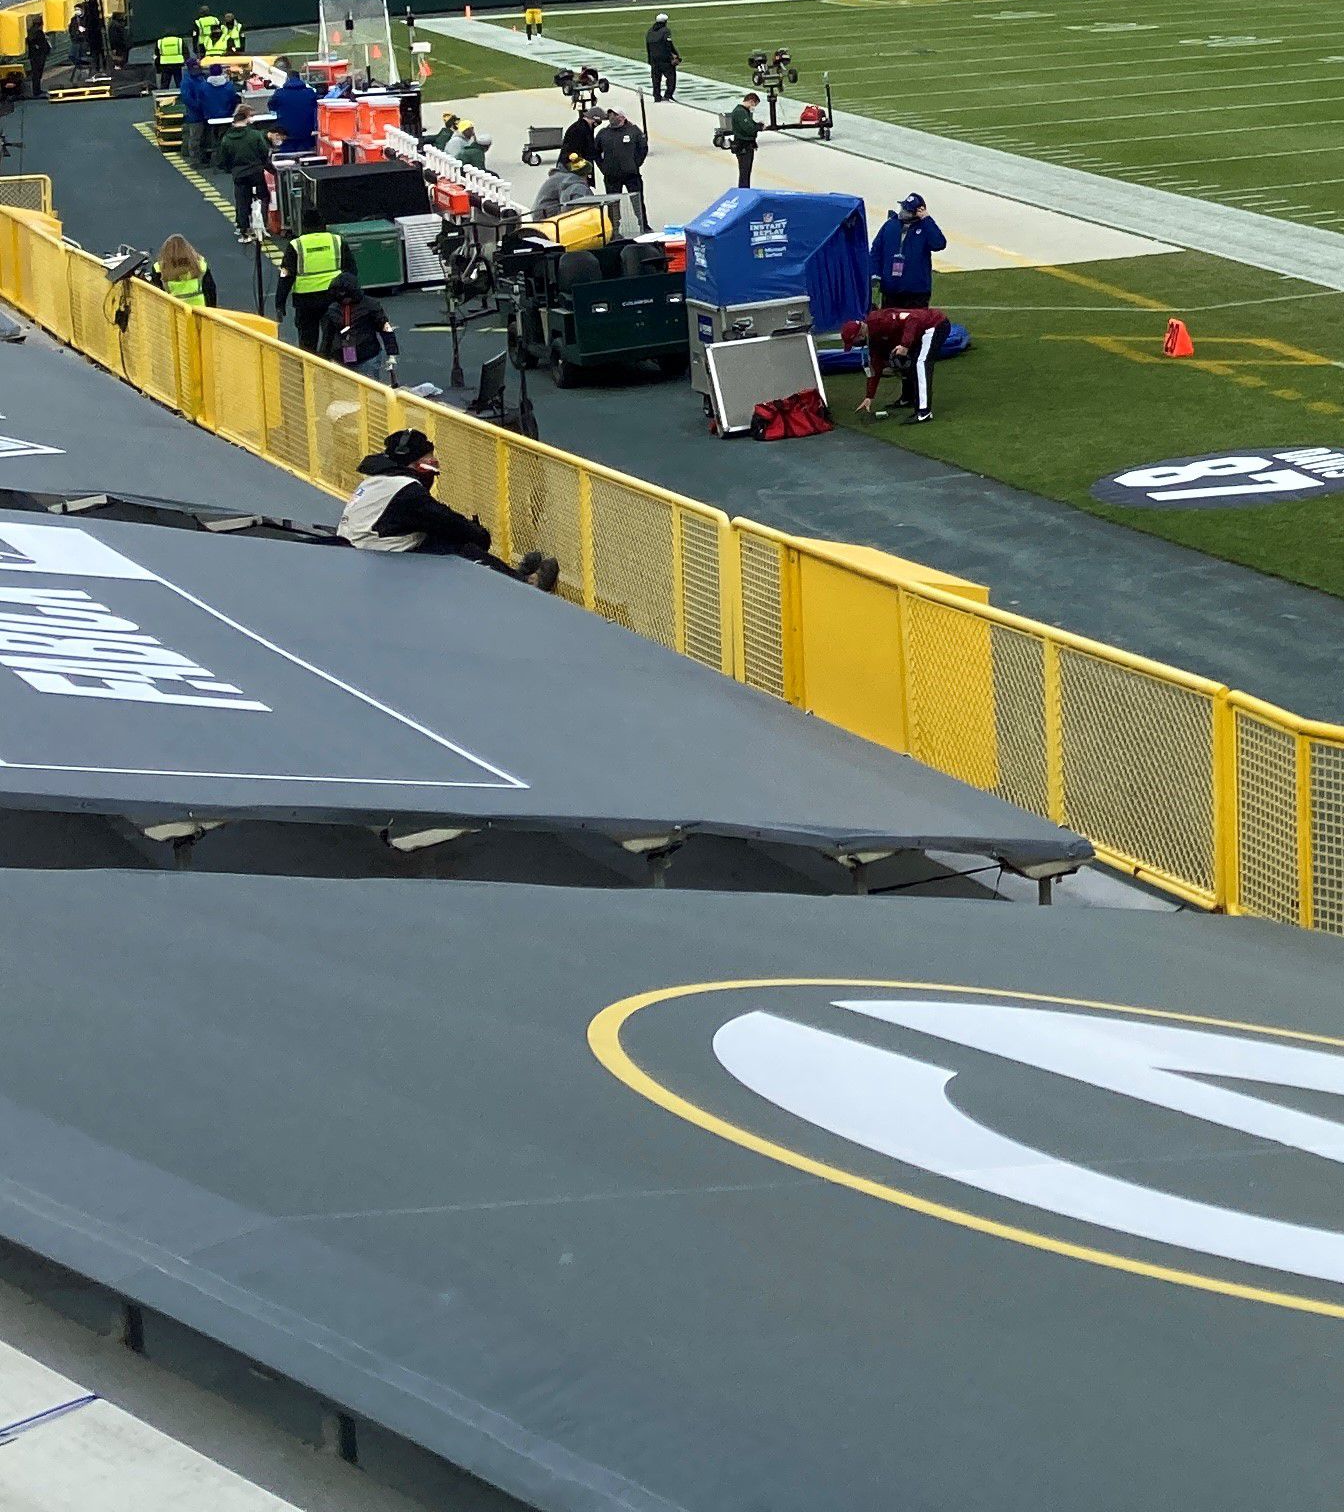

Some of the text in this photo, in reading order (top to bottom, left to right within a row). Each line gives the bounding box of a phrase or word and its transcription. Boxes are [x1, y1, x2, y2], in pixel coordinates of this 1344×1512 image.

[750, 221, 788, 231] INSTANT
[753, 228, 784, 237] REPLAY
[1113, 456, 1325, 502] 87
